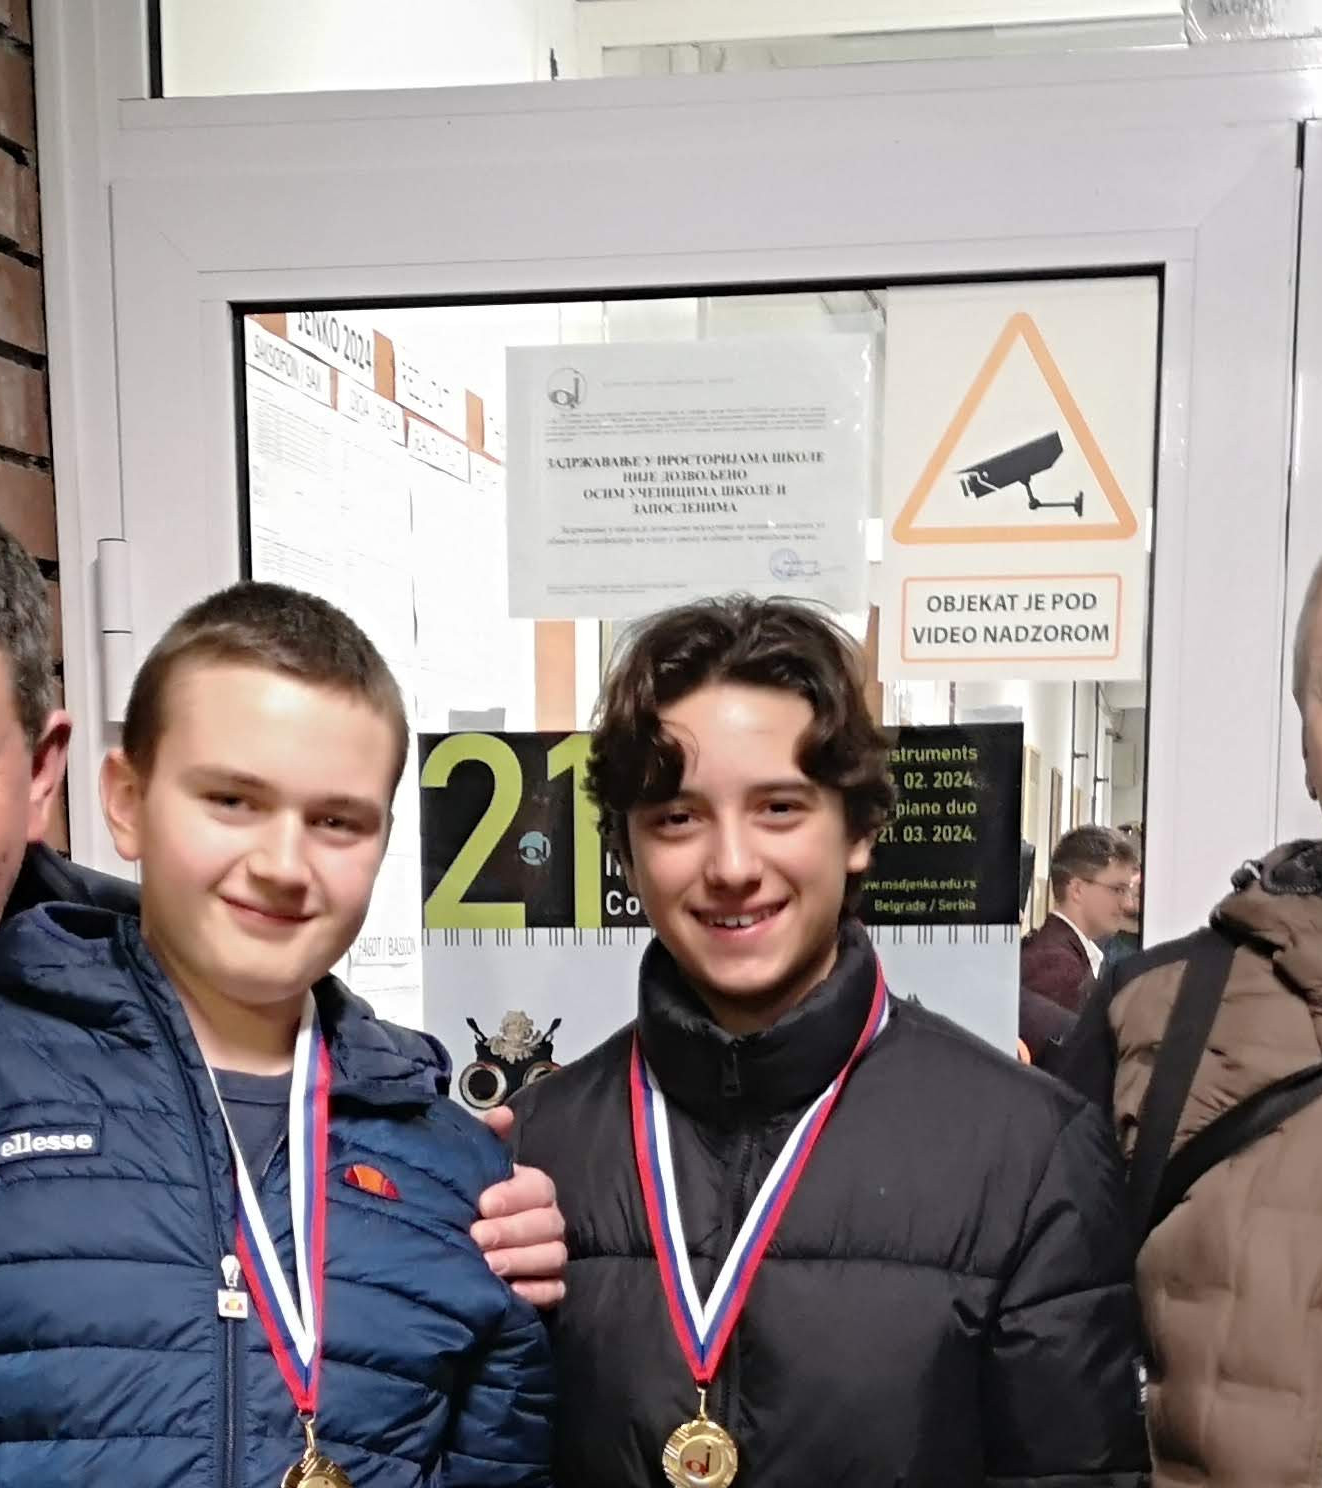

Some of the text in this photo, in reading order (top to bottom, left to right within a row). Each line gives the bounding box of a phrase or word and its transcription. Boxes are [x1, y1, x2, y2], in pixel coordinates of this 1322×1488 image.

[771, 451, 826, 465] ШКОЛЕ
[582, 487, 626, 500] ОСИМ
[720, 485, 774, 498] ШКОЛЕ
[926, 592, 1098, 613] OBJEKAT JE POD
[912, 624, 1110, 645] VIDEO NADZOROM
[886, 745, 978, 764] struments
[896, 799, 977, 819] piano duo
[420, 733, 602, 929] 21
[903, 826, 927, 843] 03.
[932, 825, 977, 843] 2024.
[938, 898, 977, 912] Serbia
[0, 1132, 94, 1157] ellesse
